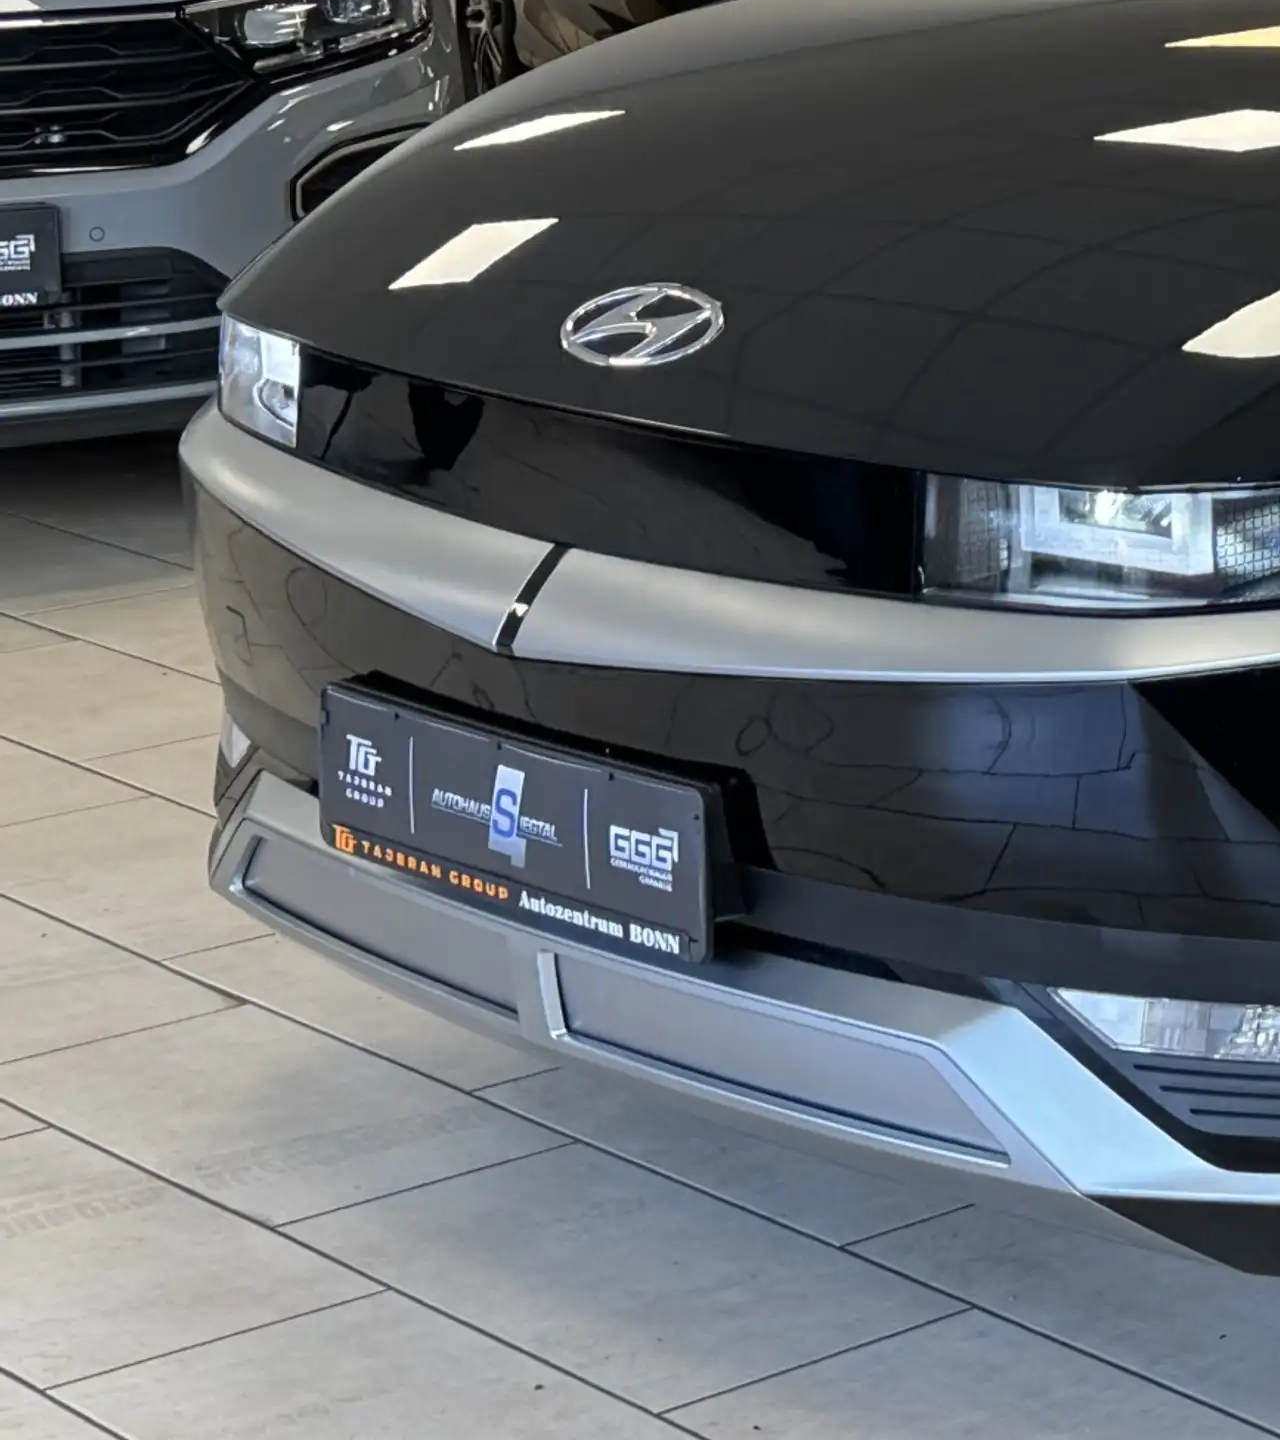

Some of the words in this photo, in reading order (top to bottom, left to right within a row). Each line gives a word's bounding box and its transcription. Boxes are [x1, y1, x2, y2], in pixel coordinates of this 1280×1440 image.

[0, 292, 38, 306] ONN
[431, 788, 493, 820] AUTOHAUS
[609, 825, 679, 871] GGG
[449, 870, 509, 900] GROUP
[518, 890, 624, 939] Autozentrum
[629, 922, 681, 955] BONN
